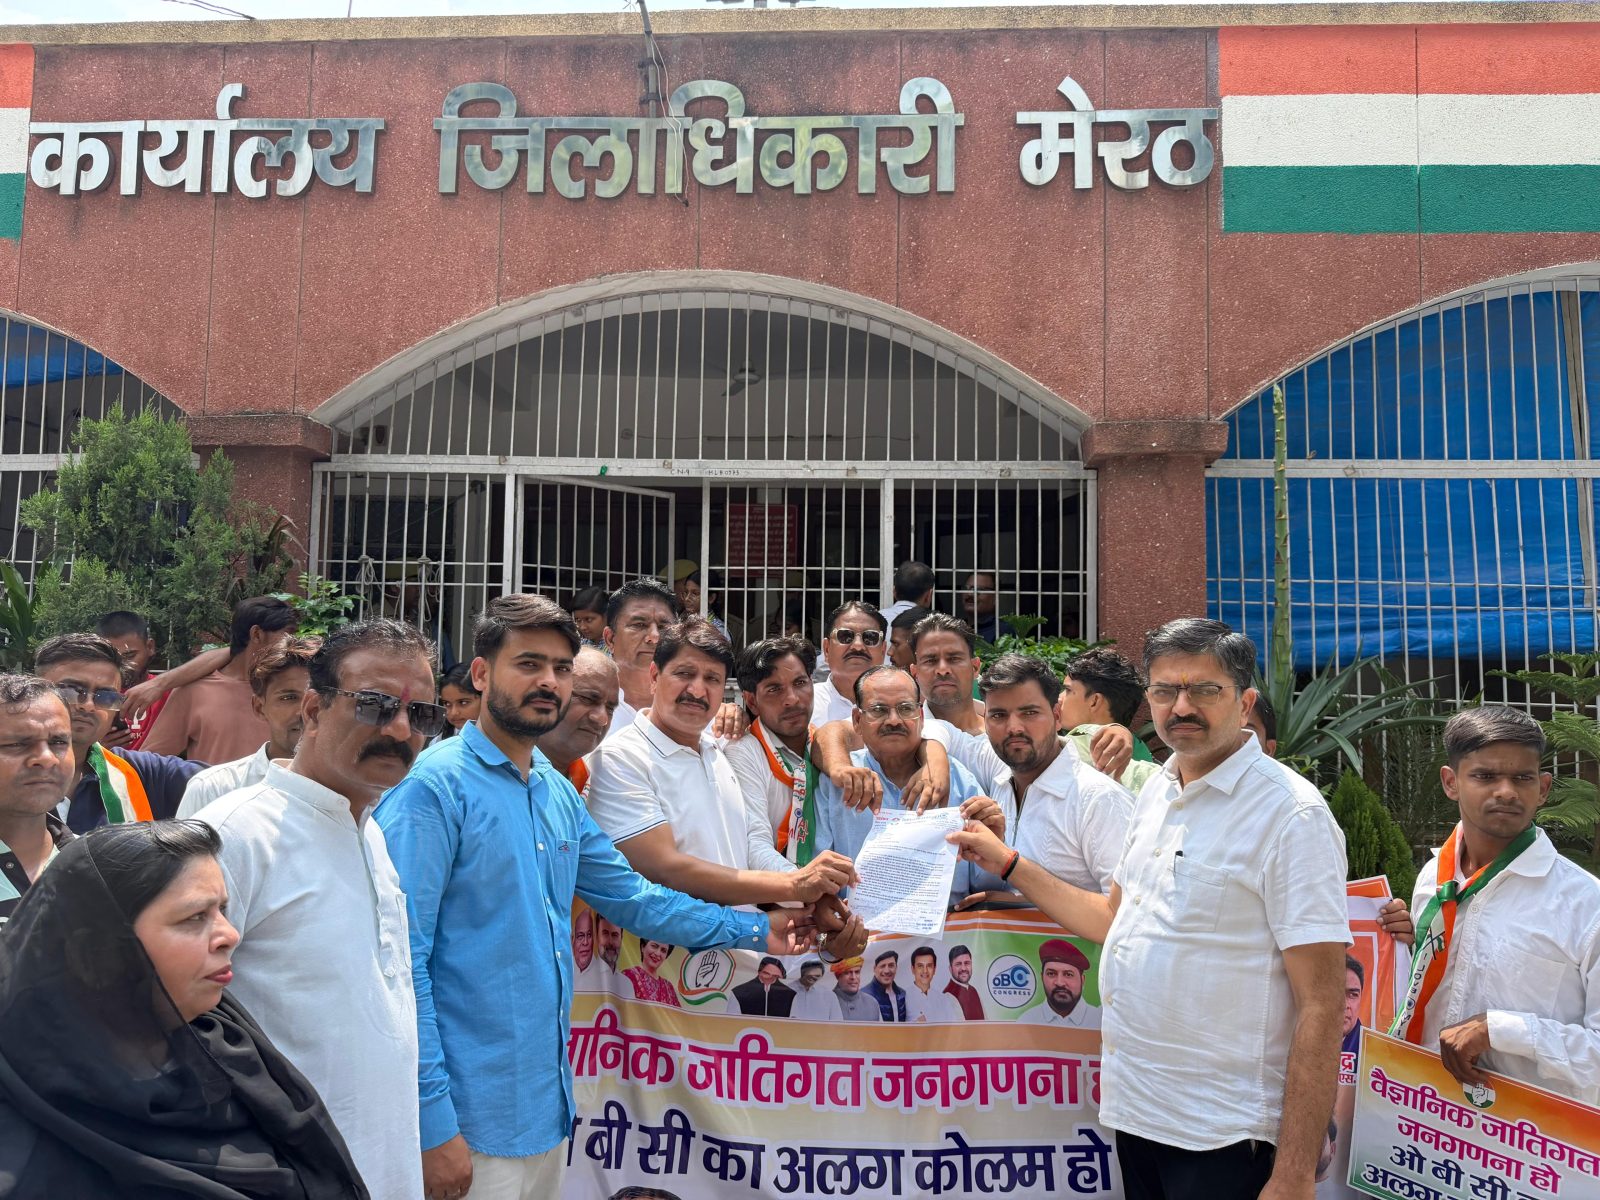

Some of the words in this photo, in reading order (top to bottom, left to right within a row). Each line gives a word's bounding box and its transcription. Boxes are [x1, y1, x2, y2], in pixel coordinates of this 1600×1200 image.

[30, 83, 385, 198] कार्यालय
[433, 77, 965, 198] जिलाधिकारी
[1016, 75, 1219, 190] मेरठ
[993, 989, 1031, 997] CONGRESS
[687, 1033, 865, 1107] जातिगत
[872, 1056, 1082, 1108] जनगणना
[585, 1100, 632, 1170] बी
[637, 1108, 695, 1175] सी
[702, 1134, 766, 1190] का
[773, 1146, 905, 1196] अलग
[912, 1131, 1056, 1195] कोलम
[1062, 1128, 1113, 1194] हो
[1370, 1067, 1477, 1130] वैज्ञानिक
[1481, 1114, 1600, 1178] जातिगत
[1397, 1114, 1525, 1181] जनगणना
[1529, 1162, 1562, 1194] हो
[1362, 1163, 1443, 1200] अलग
[1389, 1143, 1427, 1175] ओ
[1431, 1158, 1465, 1189] बी
